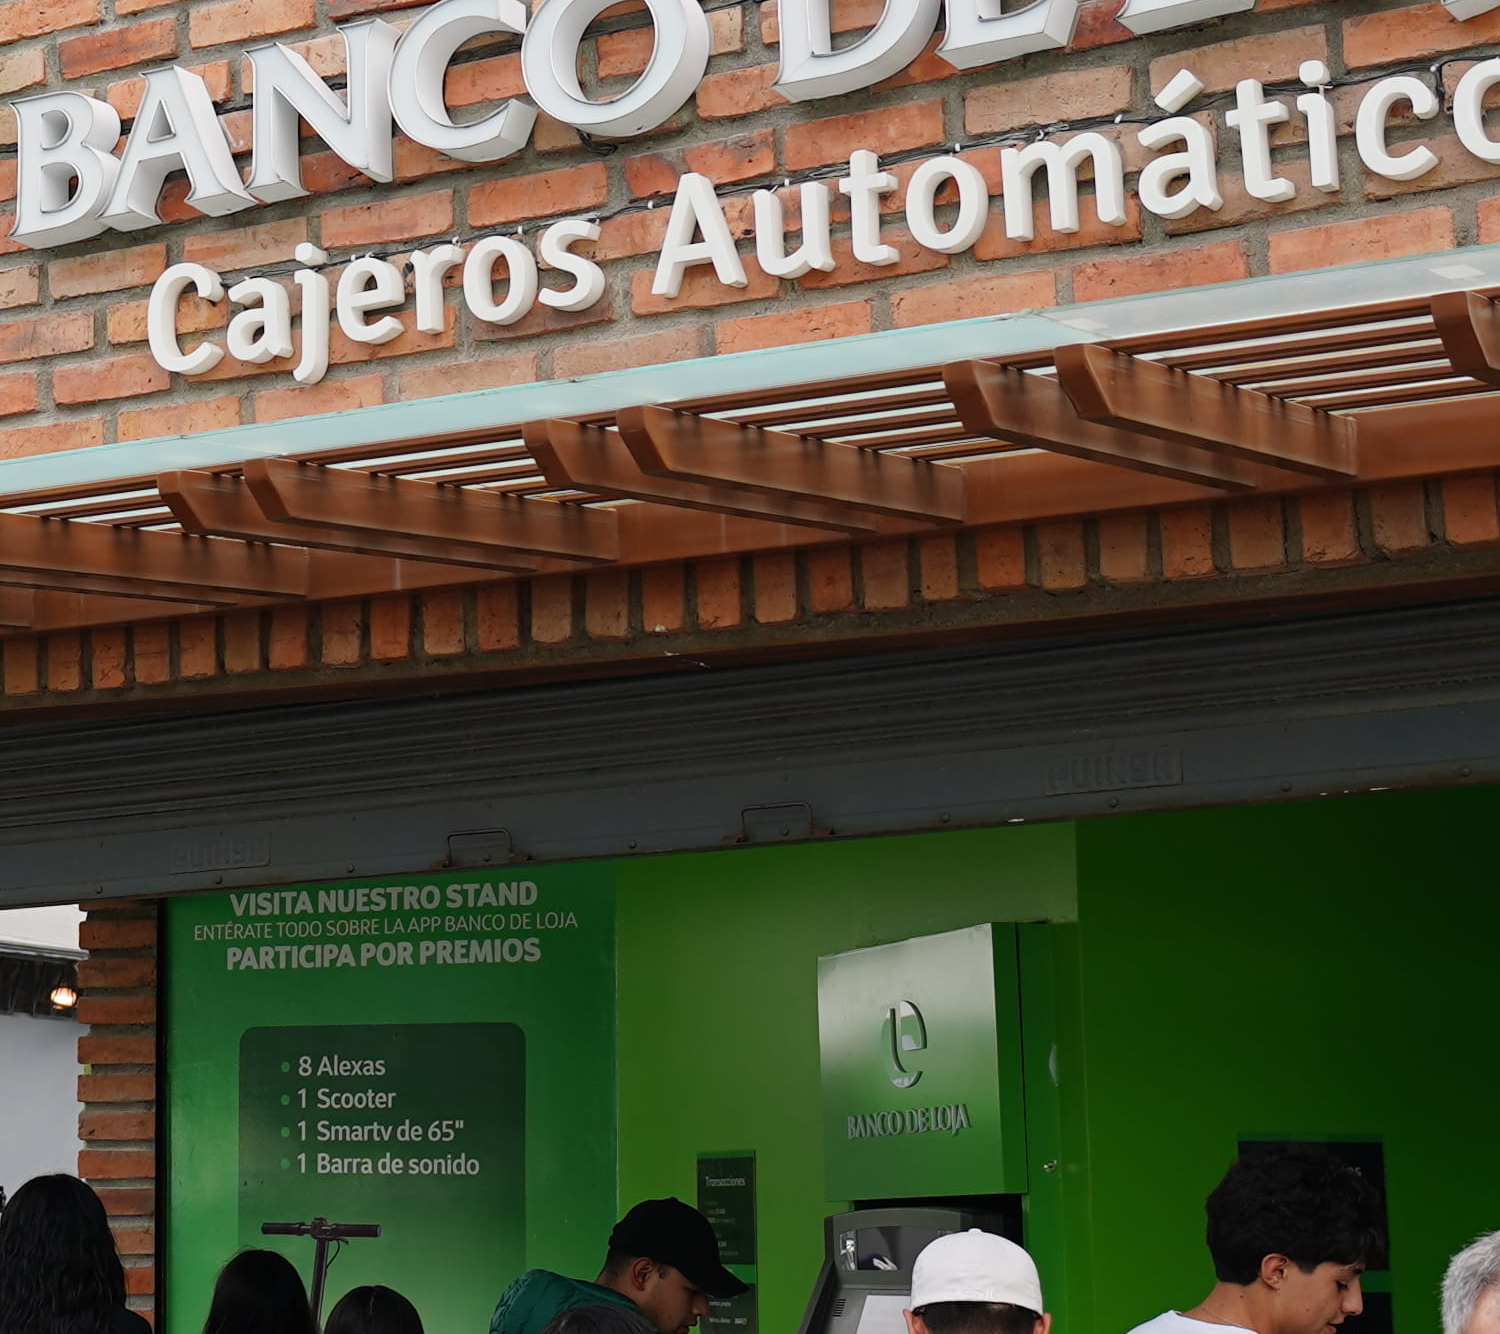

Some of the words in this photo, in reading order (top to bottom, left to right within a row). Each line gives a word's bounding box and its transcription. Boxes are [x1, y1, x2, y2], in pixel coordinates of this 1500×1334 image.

[147, 215, 607, 385] Cajeros
[230, 890, 313, 917] VISITA
[318, 884, 441, 914] NUESTRO
[445, 880, 538, 909] STAND
[194, 920, 273, 941] ENTÉRATE
[276, 921, 322, 938] TODO
[325, 919, 380, 937] SOBRE
[384, 917, 406, 934] LA
[407, 916, 441, 934] APP
[444, 913, 506, 932] BANCO
[510, 912, 532, 930] DE
[536, 910, 578, 930] LOJA
[226, 943, 356, 970] PARTICIPA
[360, 941, 414, 967] POR
[419, 937, 541, 965] PREMIOS
[298, 1055, 312, 1076] 8
[317, 1054, 386, 1076] Alexas
[297, 1088, 307, 1108] 1
[317, 1087, 396, 1108] Scooter
[297, 1120, 307, 1141] 1
[317, 1120, 393, 1141] Smartv
[396, 1119, 423, 1141] de
[428, 1119, 464, 1141] 65"
[847, 1110, 904, 1139] BANCO
[906, 1107, 929, 1133] DE
[931, 1103, 971, 1136] LOJA
[297, 1153, 307, 1173] 1
[317, 1153, 373, 1174] Barra
[377, 1152, 404, 1174] de
[408, 1152, 480, 1175] sonido
